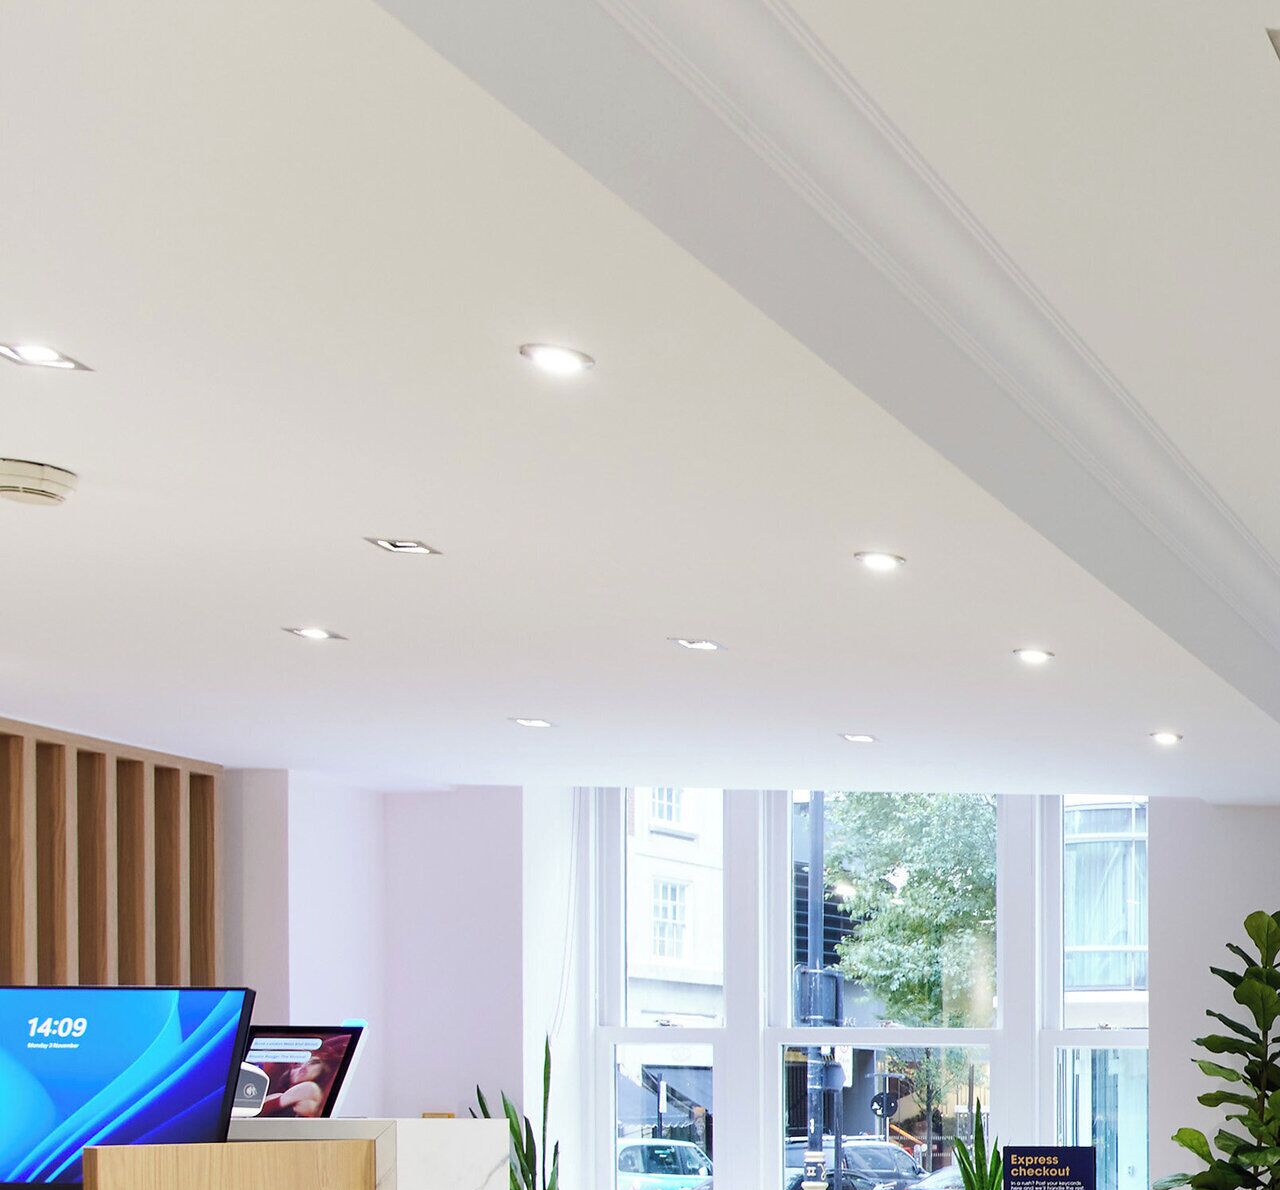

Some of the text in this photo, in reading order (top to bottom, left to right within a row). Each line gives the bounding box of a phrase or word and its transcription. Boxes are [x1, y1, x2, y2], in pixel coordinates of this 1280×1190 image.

[28, 1017, 88, 1038] 14:09
[1011, 1154, 1059, 1166] Express
[1011, 1166, 1070, 1176] checkout
